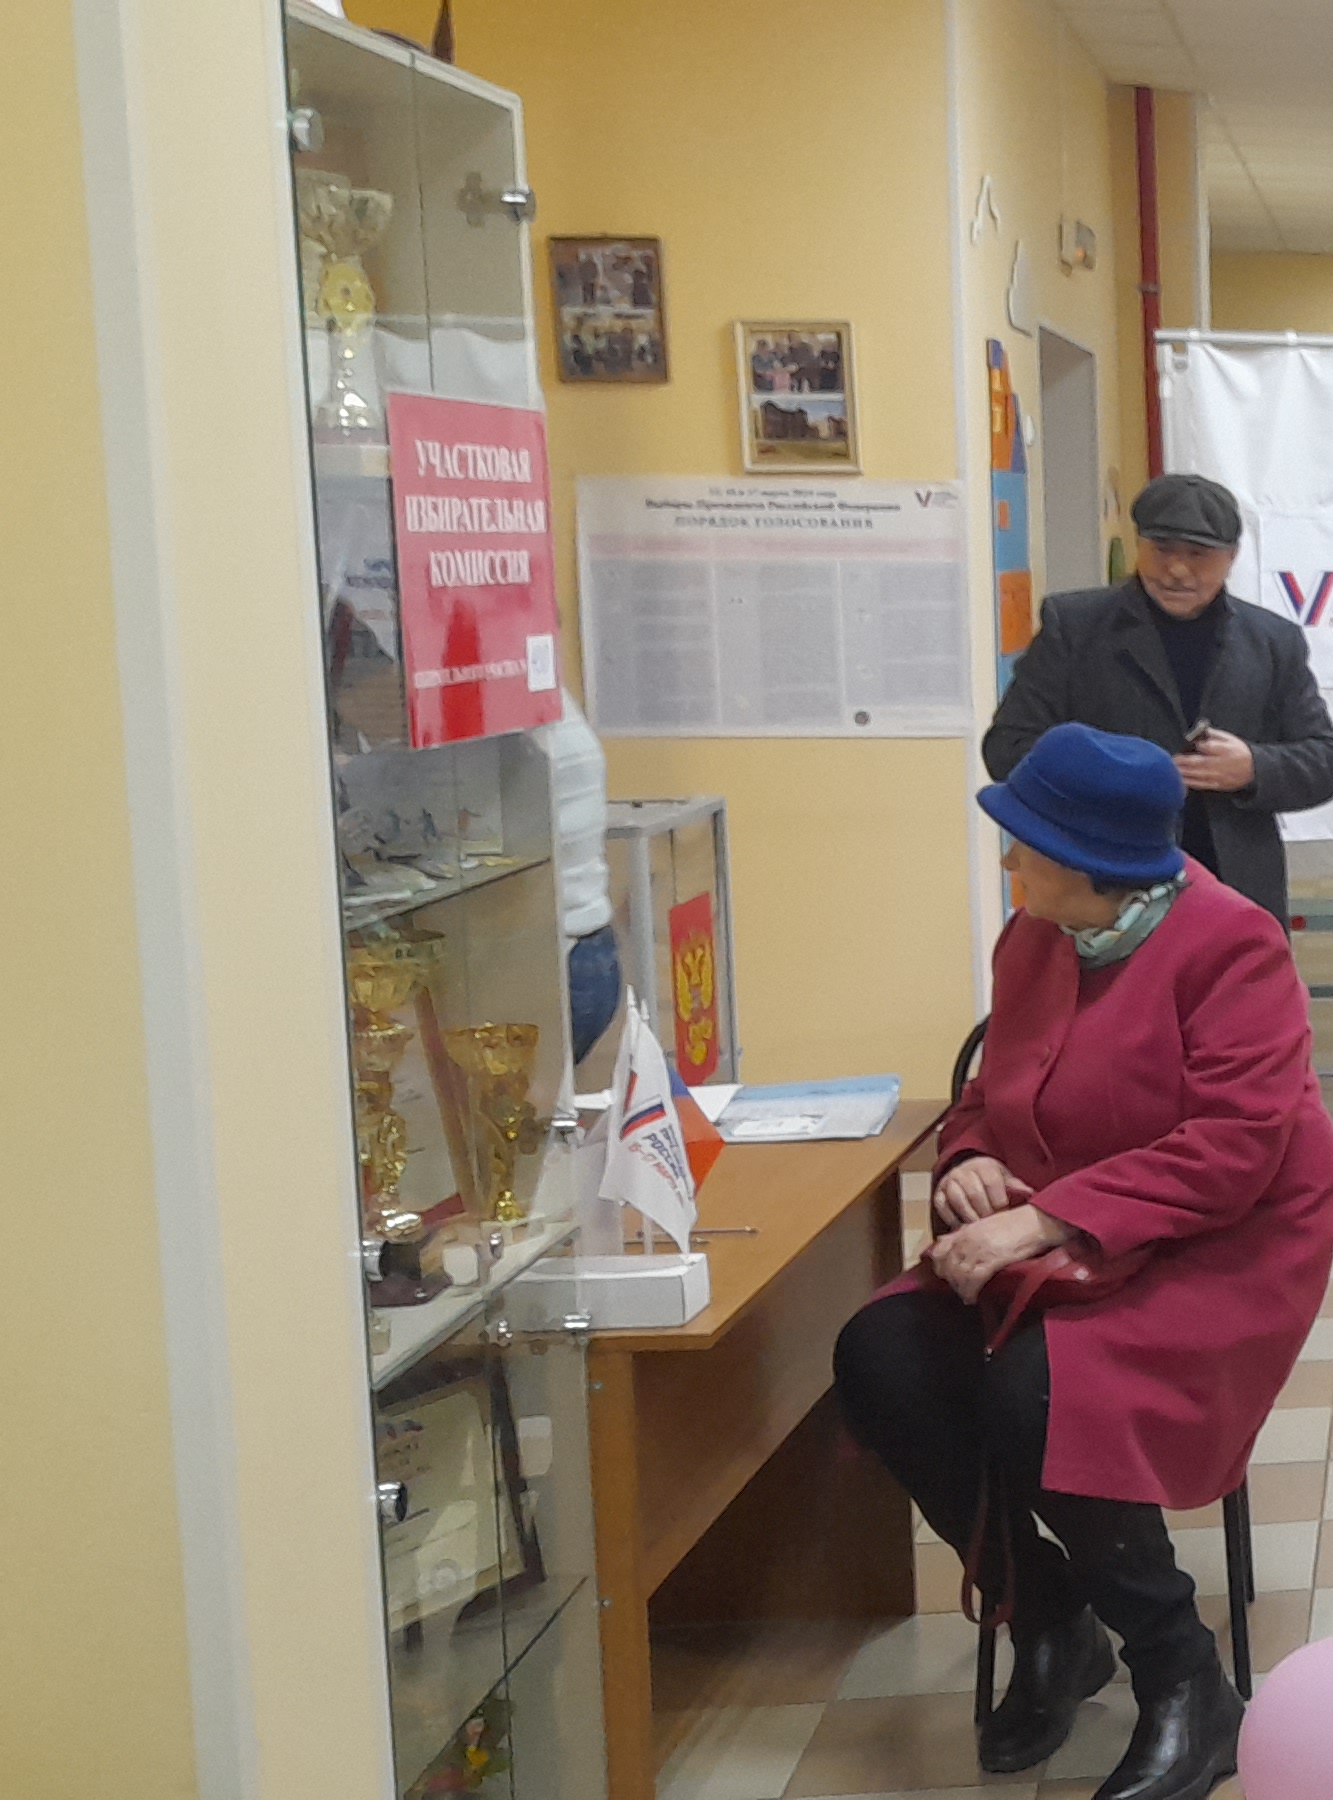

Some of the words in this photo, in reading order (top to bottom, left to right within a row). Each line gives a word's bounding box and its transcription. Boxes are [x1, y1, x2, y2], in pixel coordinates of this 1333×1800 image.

[414, 439, 532, 483] УЧАСТКОВАЯ
[404, 495, 548, 534] ИЗБИРАТЕЛЬНАЯ
[430, 550, 531, 588] КОМИССИЯ
